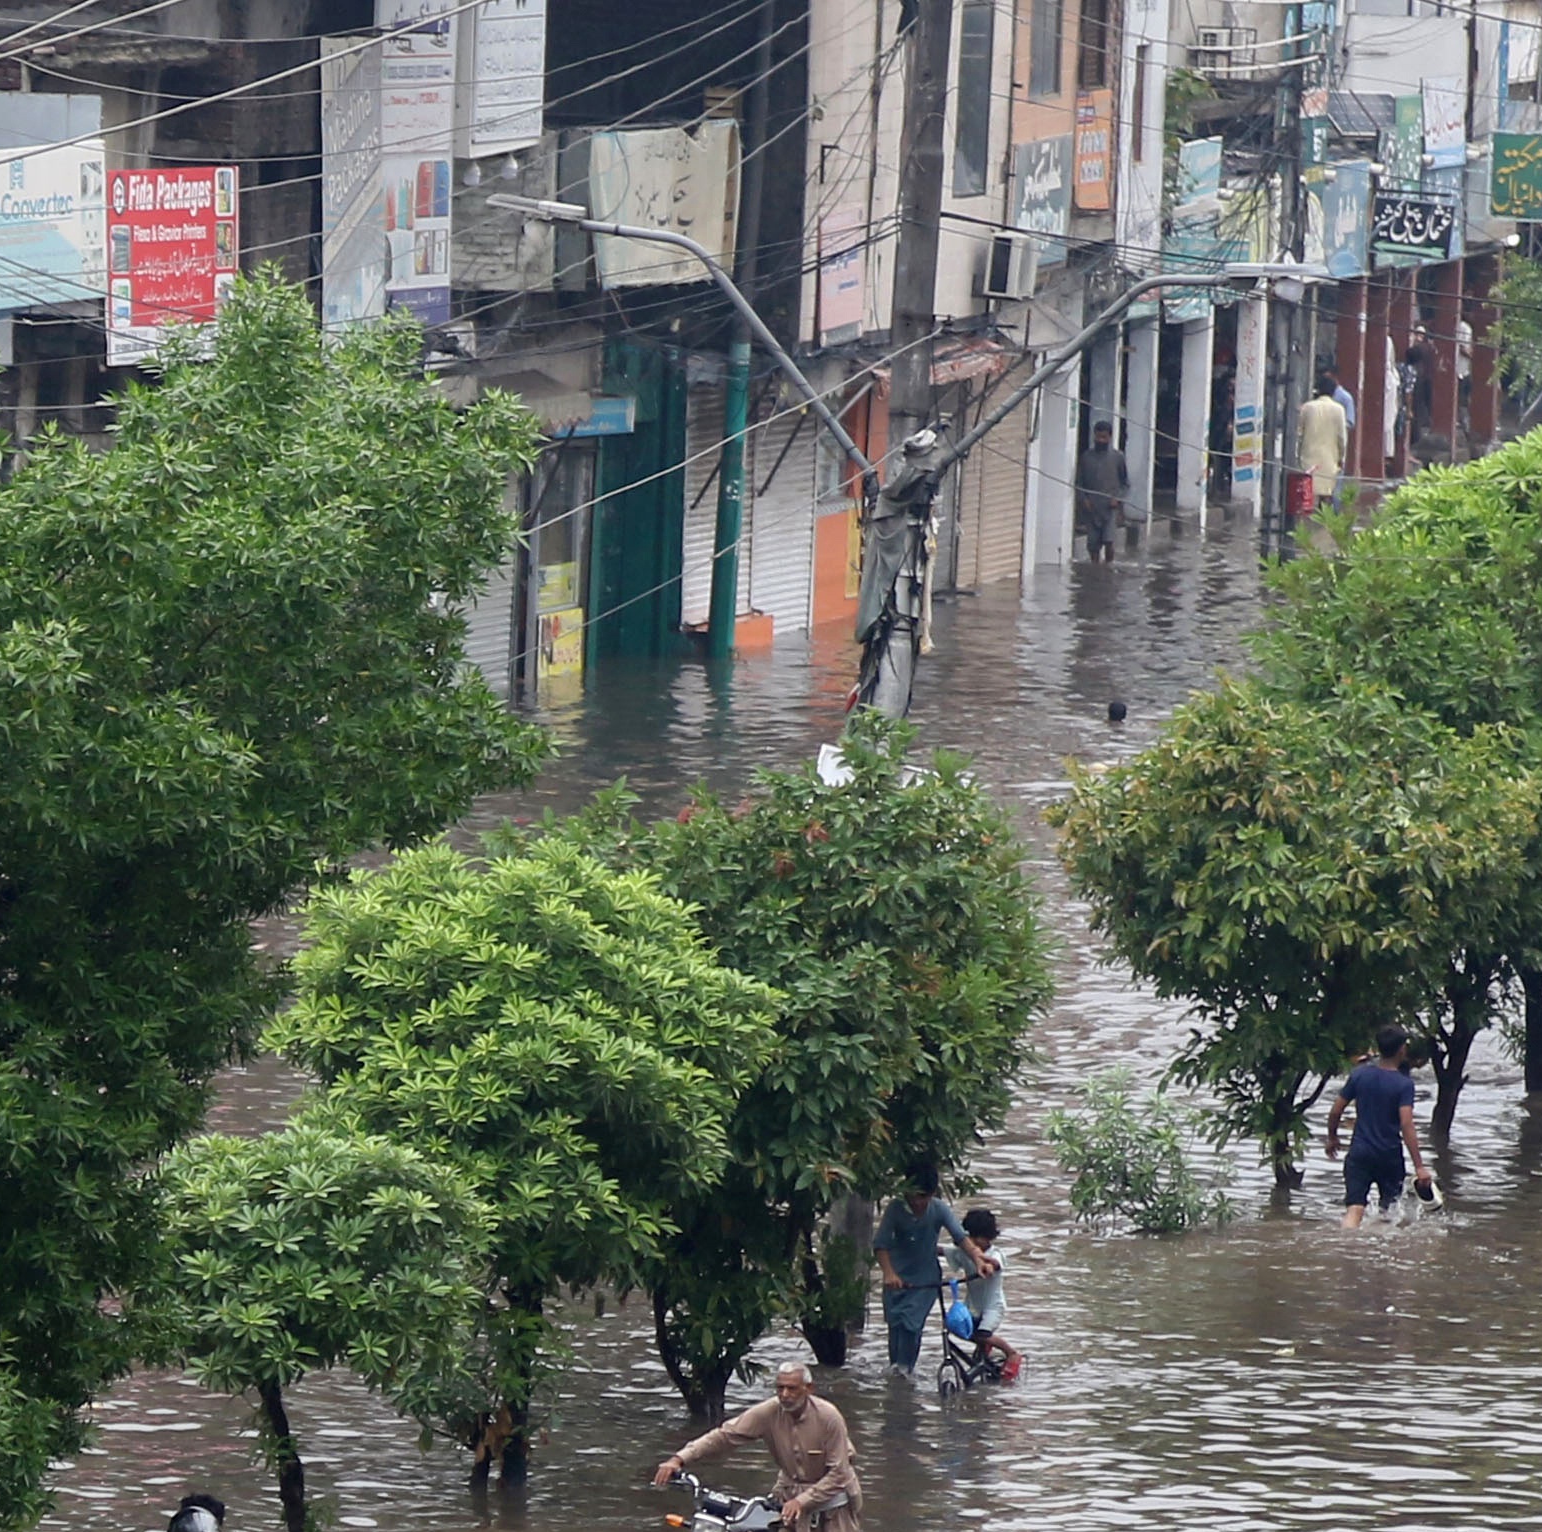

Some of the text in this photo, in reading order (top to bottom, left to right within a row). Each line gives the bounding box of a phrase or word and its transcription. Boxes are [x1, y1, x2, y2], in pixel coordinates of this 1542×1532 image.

[328, 89, 372, 160] Madina
[0, 191, 73, 221] Convertec
[128, 173, 211, 217] Fida Packages
[1408, 204, 1453, 243] عثمان
